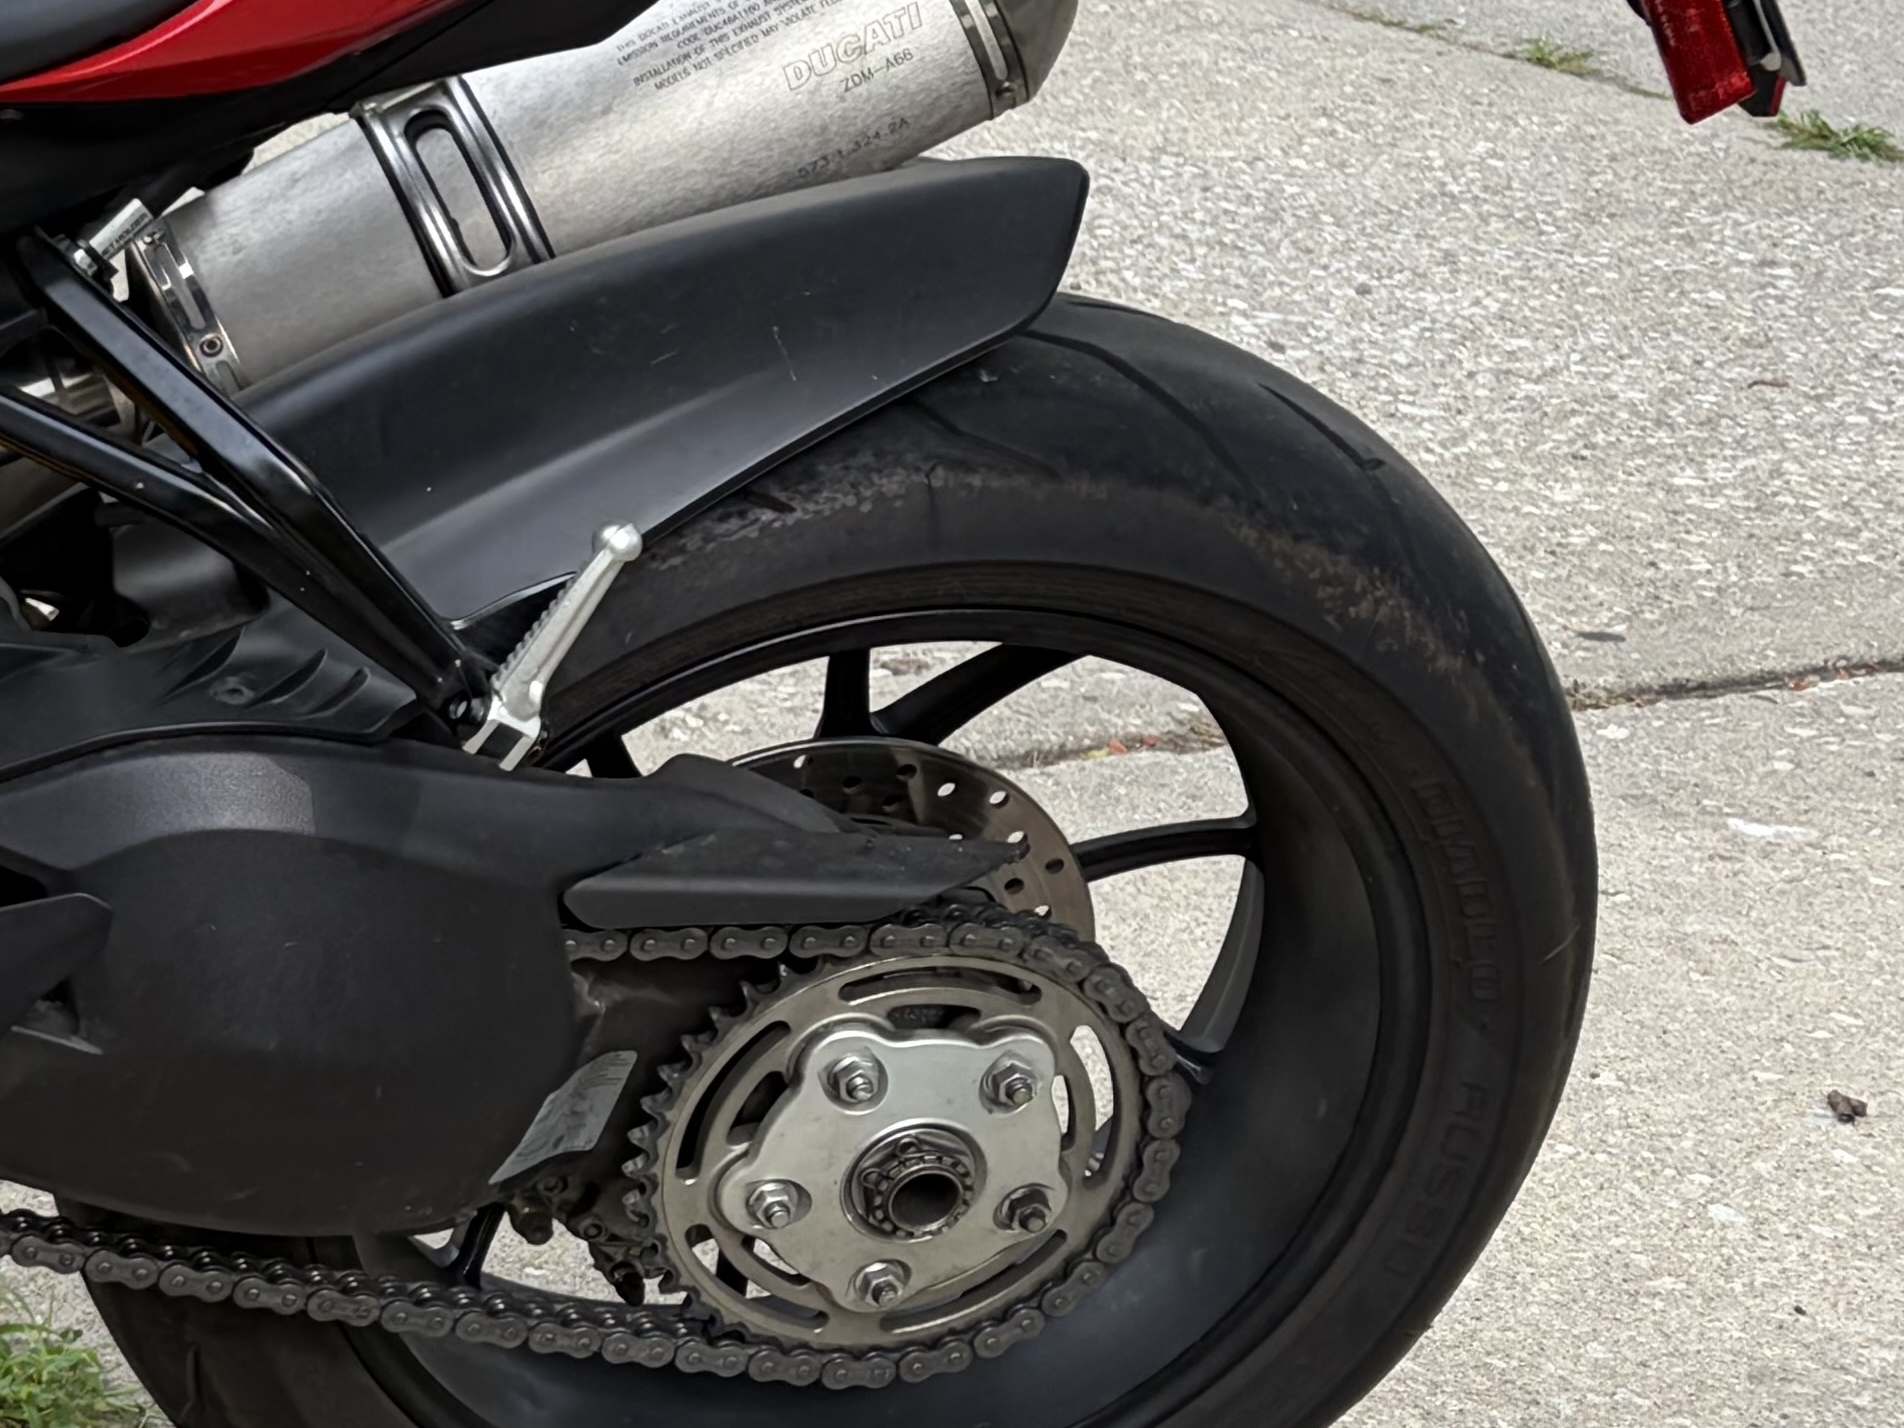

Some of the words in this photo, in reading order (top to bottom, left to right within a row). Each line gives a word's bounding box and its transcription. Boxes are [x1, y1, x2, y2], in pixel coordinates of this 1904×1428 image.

[631, 49, 693, 88] INSTALLATION
[692, 43, 707, 57] OF
[707, 31, 731, 49] THIS
[731, 9, 772, 37] EXHAUST
[653, 66, 692, 93] MODELS
[691, 55, 713, 73] NOT
[711, 32, 760, 63] SPECIFIED
[760, 22, 780, 39] MAY
[779, 3, 818, 29] VIOLATE
[658, 4, 727, 45] REQUIREMENTS
[675, 32, 701, 51] CODE
[781, 1, 923, 91] DUCATI
[838, 45, 915, 93] ZDM-A66
